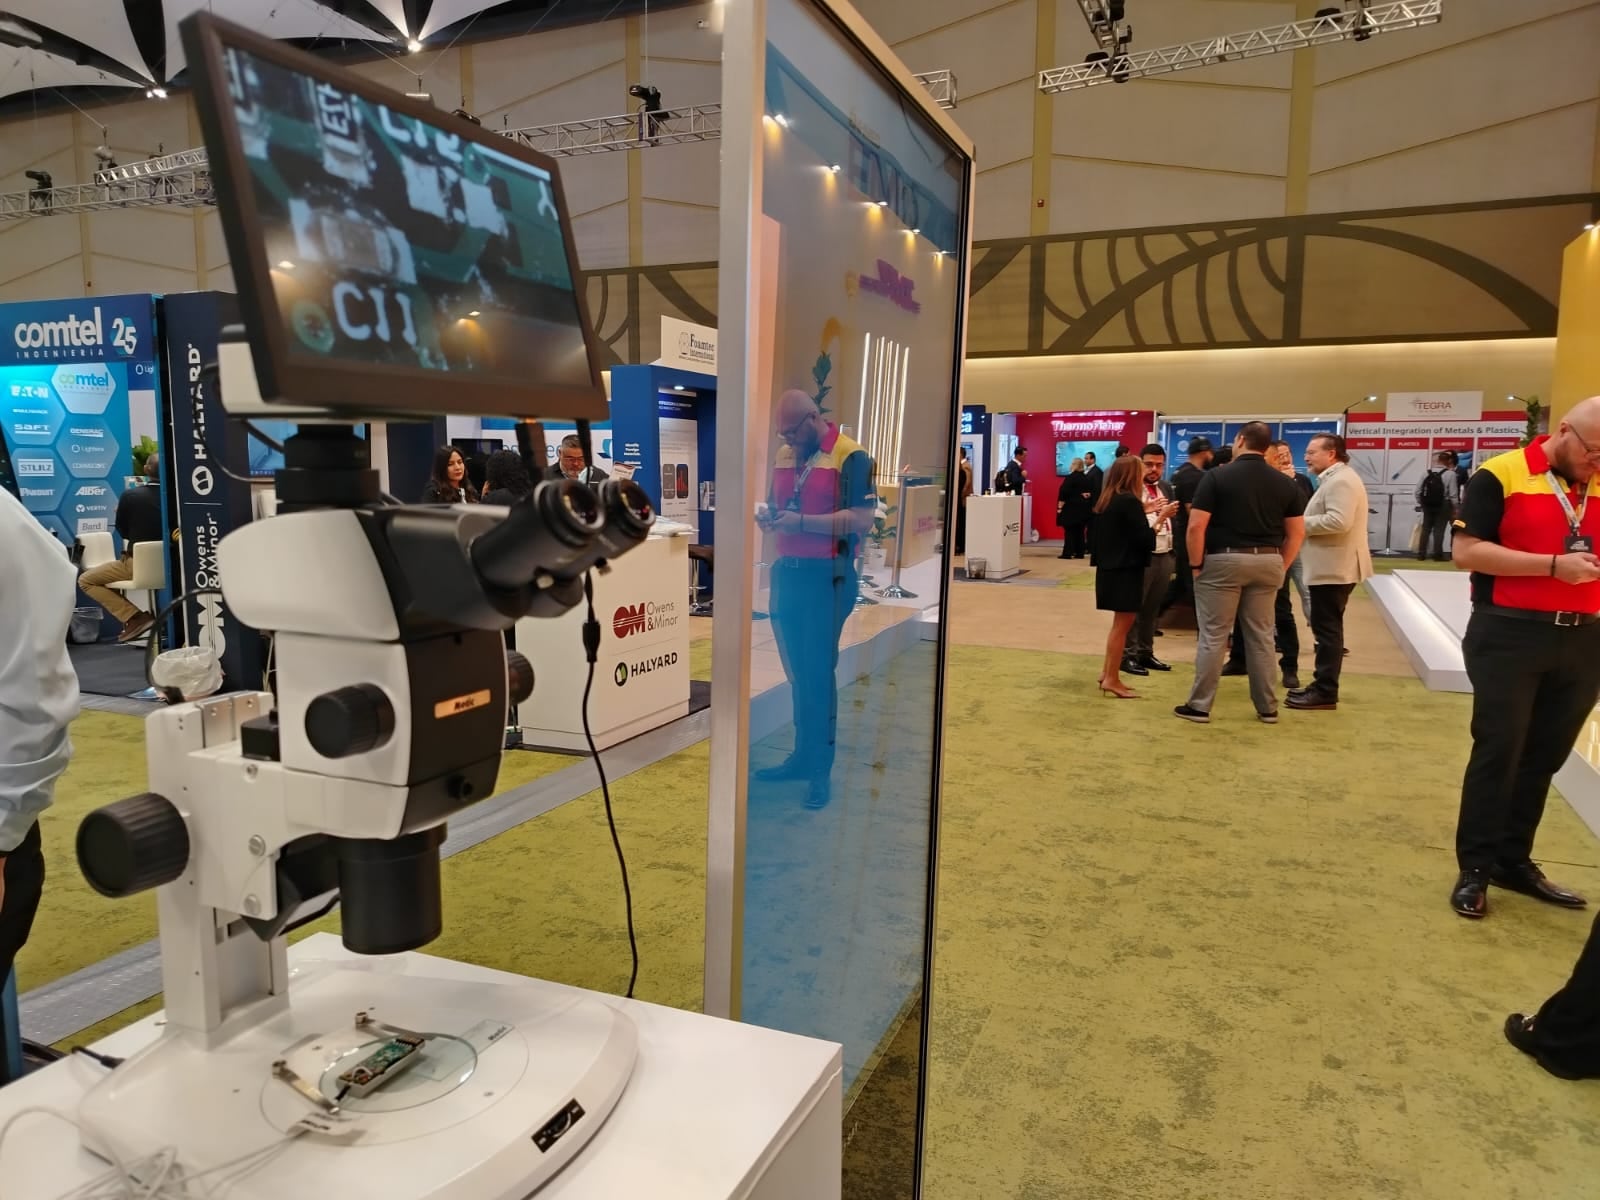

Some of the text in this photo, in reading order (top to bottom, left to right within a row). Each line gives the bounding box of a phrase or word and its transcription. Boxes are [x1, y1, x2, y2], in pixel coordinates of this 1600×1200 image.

[14, 306, 104, 349] comtel
[111, 317, 137, 355] 25
[16, 347, 104, 359] INGENIERIA
[60, 372, 109, 388] comtel
[1416, 402, 1451, 410] TEGRA
[1053, 430, 1124, 438] SCIENTIFIC
[1348, 427, 1380, 435] Vertical
[1384, 427, 1431, 436] Integration
[196, 525, 208, 588] Owens
[647, 601, 675, 616] Owens
[647, 614, 678, 631] &Minor
[631, 651, 678, 678] HALYARD
